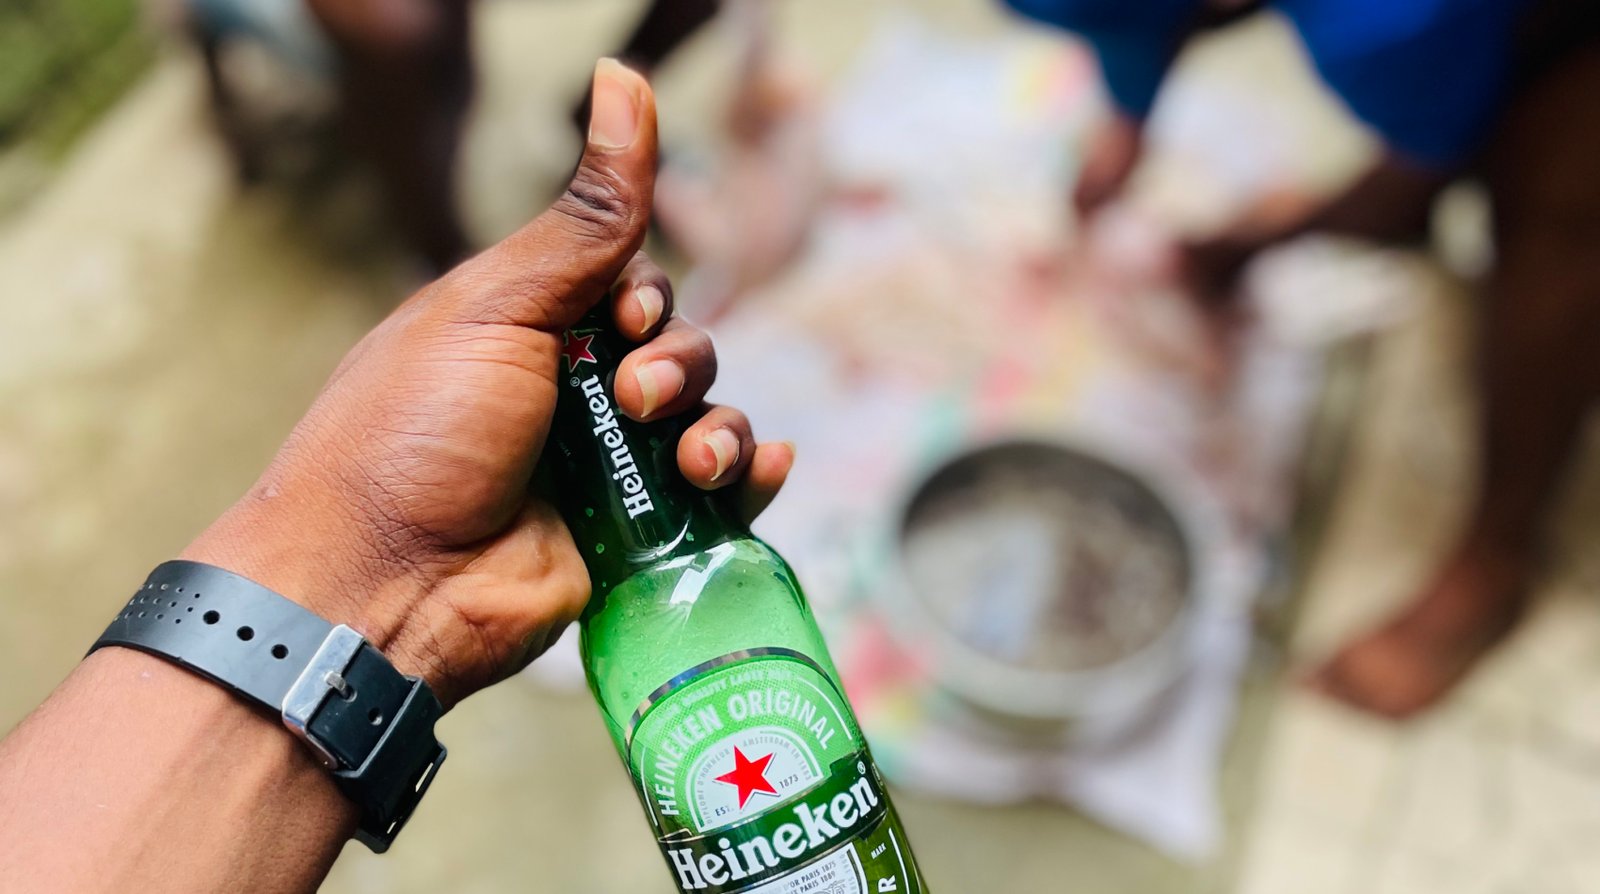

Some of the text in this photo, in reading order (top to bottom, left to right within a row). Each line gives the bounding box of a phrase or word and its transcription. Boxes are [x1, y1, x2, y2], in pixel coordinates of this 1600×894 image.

[581, 374, 654, 519] Heineken
[656, 704, 724, 816] HEINEKEN
[727, 688, 836, 750] ORIGINAL
[743, 736, 790, 748] AMSTERDAM
[779, 774, 799, 788] 1873
[667, 775, 879, 890] Heineken
[801, 869, 820, 883] PARIS
[821, 861, 836, 873] 1875
[800, 880, 819, 893] PARIS
